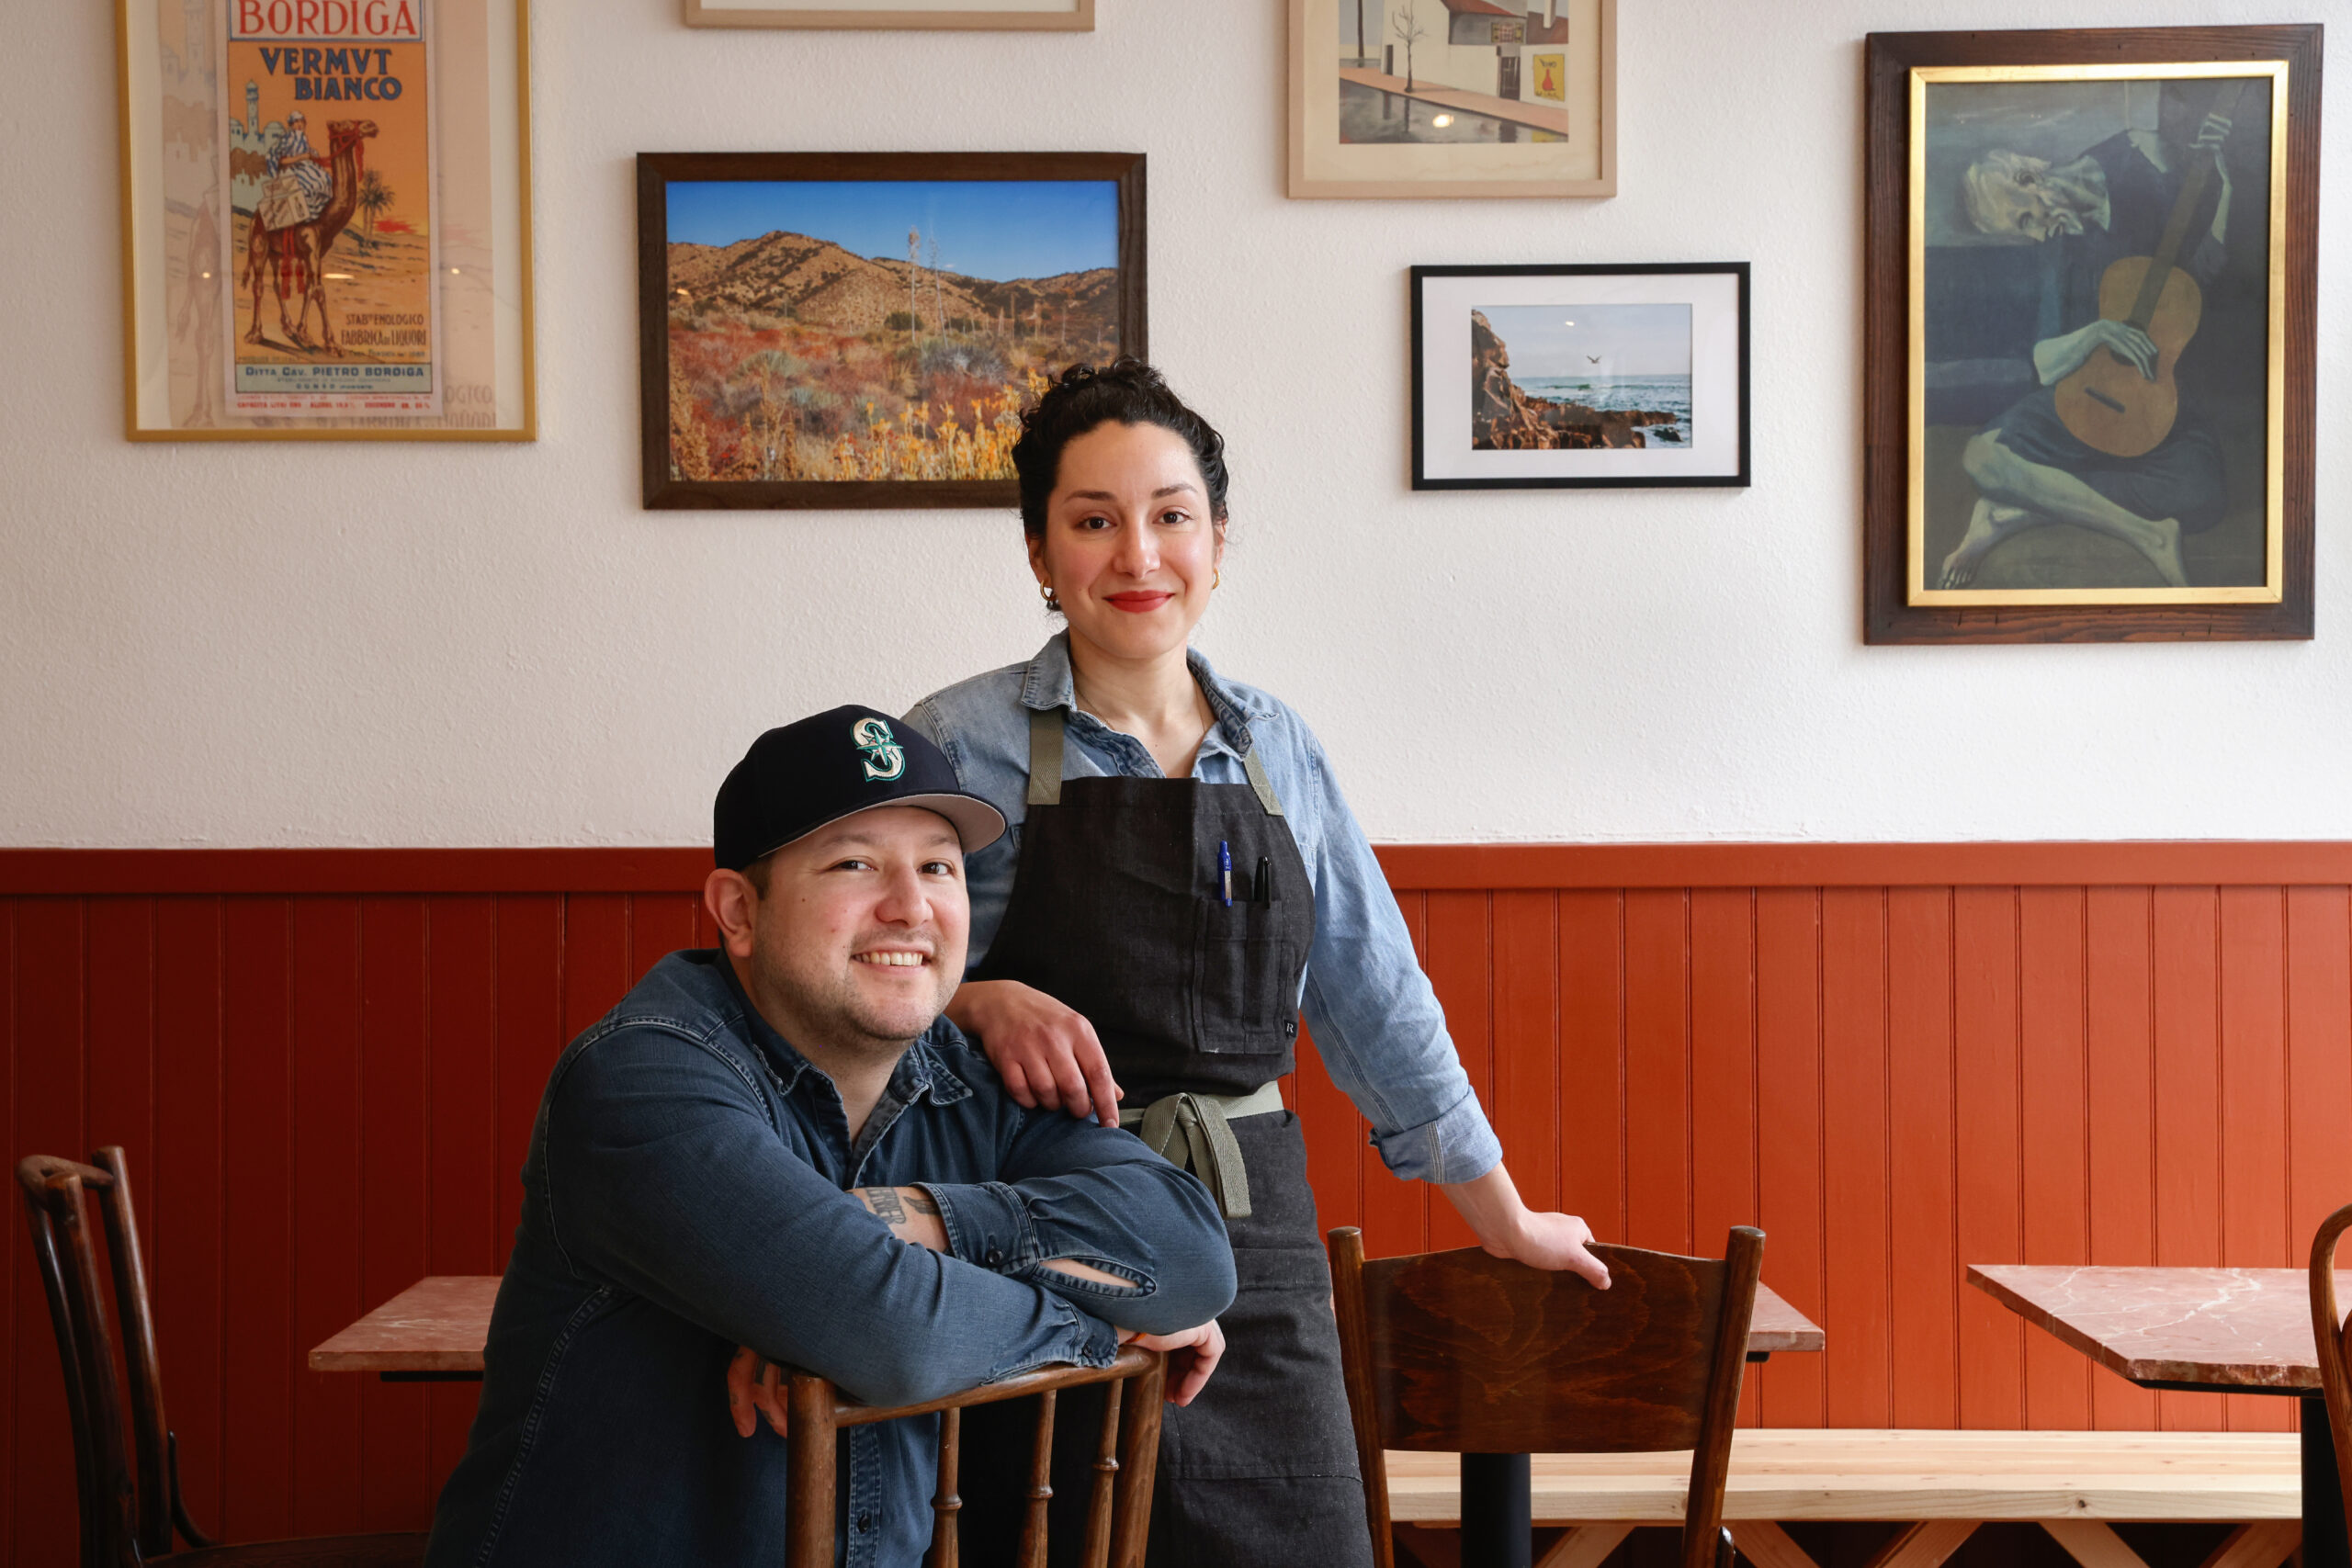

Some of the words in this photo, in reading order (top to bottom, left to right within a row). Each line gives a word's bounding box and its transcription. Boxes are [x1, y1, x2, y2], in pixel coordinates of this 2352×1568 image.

[239, 0, 417, 35] BORDIGA
[294, 77, 402, 100] BIANCO
[374, 313, 424, 325] ENOLOGICO
[341, 330, 382, 345] FABBRICA
[312, 367, 359, 377] PIETRO
[365, 367, 424, 377] BORDIGA
[850, 717, 906, 783] S
[1286, 1022, 1295, 1033] R
